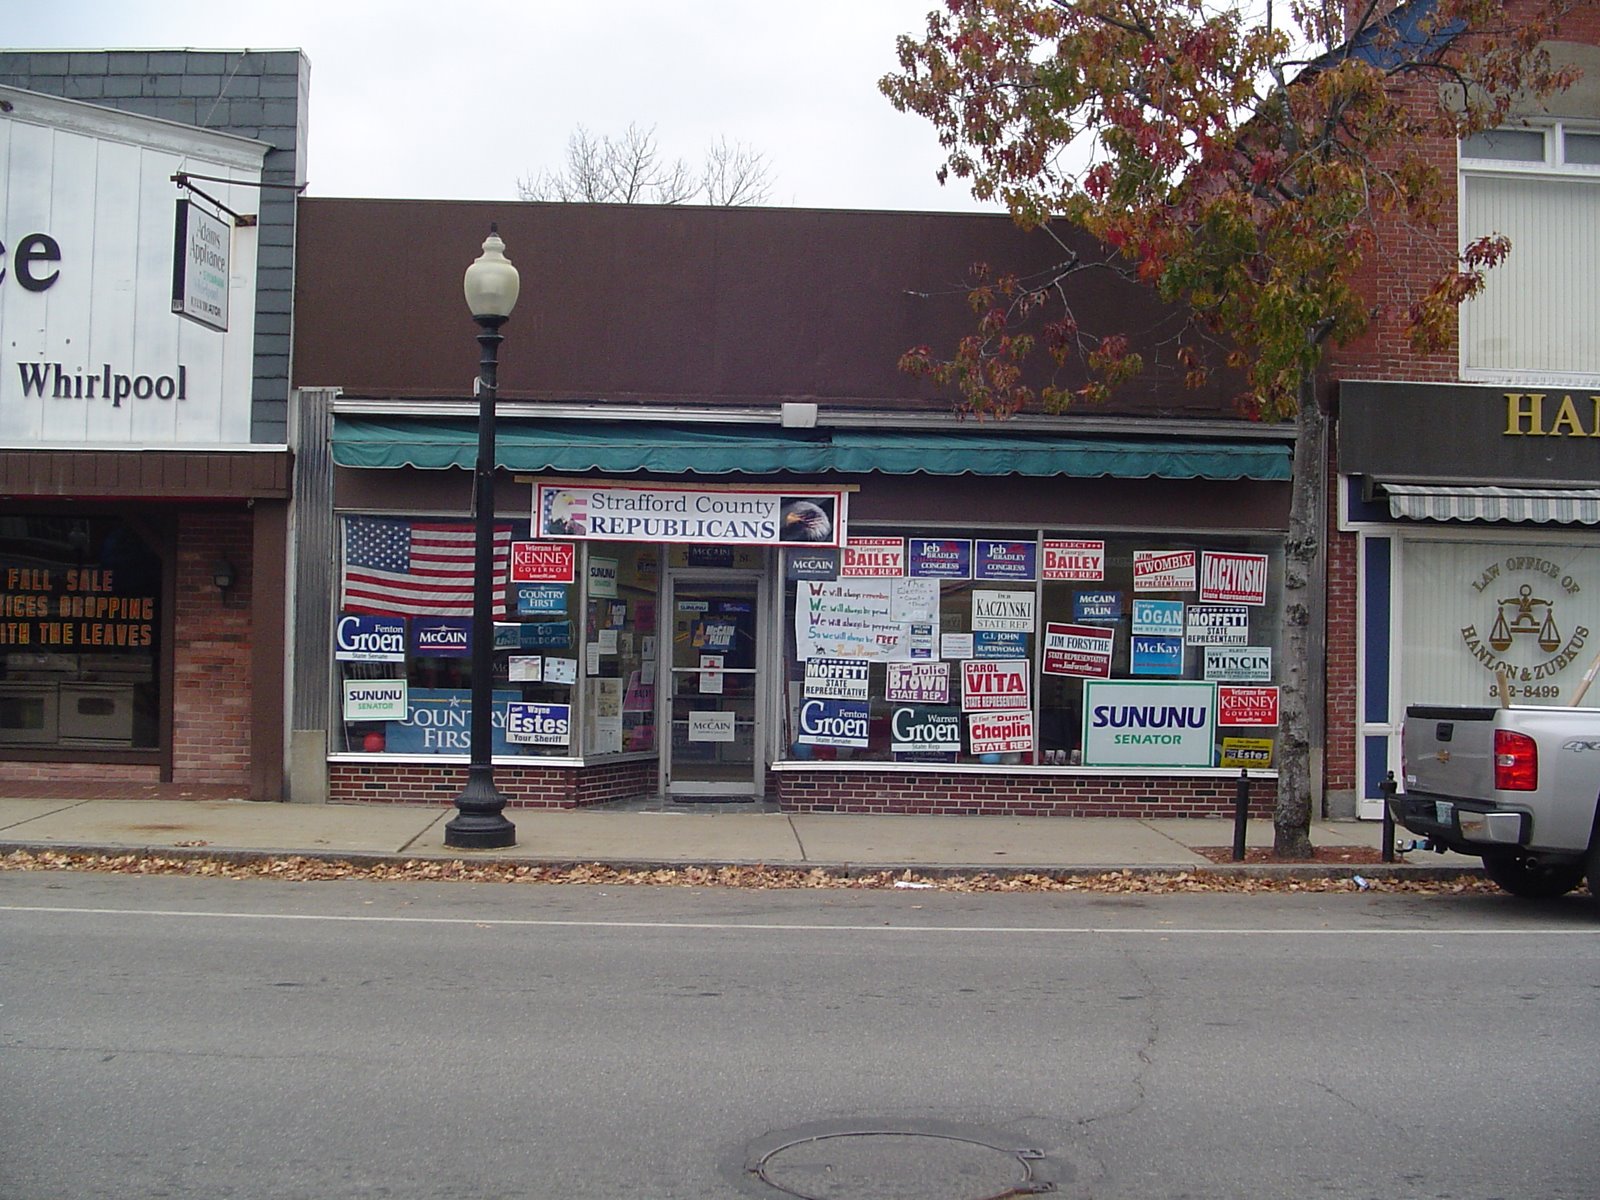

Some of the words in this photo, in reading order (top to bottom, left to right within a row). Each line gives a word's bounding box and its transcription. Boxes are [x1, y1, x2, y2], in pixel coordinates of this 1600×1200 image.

[196, 215, 222, 249] Adams
[189, 236, 226, 273] Appliance
[0, 232, 62, 293] e
[17, 362, 187, 408] Whirlpool
[1503, 393, 1600, 438] HA
[591, 492, 688, 514] Strafford
[695, 496, 776, 518] County
[590, 516, 776, 540] REPUBLICANS
[920, 542, 941, 556] Jeb
[987, 544, 1007, 558] Jeb
[514, 552, 572, 565] KENNEY
[844, 548, 901, 567] BAILEY
[926, 552, 960, 560] BRADLEY
[1045, 551, 1100, 570] BAILEY
[793, 560, 834, 570] McCAIN
[920, 562, 960, 570] CONGRESS
[1135, 554, 1192, 576] TWOMBLY
[590, 567, 616, 579] SUNUNU
[843, 568, 877, 577] STATE
[878, 568, 901, 577] REP.
[1045, 571, 1077, 579] STATE
[1078, 571, 1101, 580] REP.
[1471, 562, 1501, 593] LAW
[1505, 556, 1561, 579] OFFICE
[1561, 575, 1581, 594] OF
[8, 568, 53, 592] FALL
[66, 568, 113, 593] SALE
[907, 580, 925, 589] The
[1135, 580, 1194, 588] REPRESENTATIVE
[519, 589, 564, 599] COUNTRY
[809, 582, 827, 597] We
[829, 587, 843, 597] will
[843, 588, 862, 601] always
[529, 599, 555, 607] FIRST
[1079, 594, 1116, 604] McCAIN
[0, 593, 49, 618] ICES
[59, 596, 154, 620] DROPPING
[809, 598, 827, 612] We
[830, 603, 844, 613] will
[844, 604, 862, 615] always
[976, 598, 1032, 618] KACZYNSKI
[1083, 607, 1112, 616] PALIN
[809, 612, 826, 626] We
[828, 617, 842, 627] will
[1134, 606, 1182, 624] LOGAN
[1188, 613, 1247, 627] MOFFETT
[374, 623, 404, 634] Fenton
[537, 626, 553, 635] GO
[705, 625, 736, 636] McCAIN
[977, 620, 1007, 628] STATE
[39, 623, 73, 645] THE
[81, 623, 152, 646] LEAVES
[337, 616, 405, 652] Groen
[419, 631, 467, 643] McCAIN
[808, 626, 821, 639] So
[834, 632, 846, 641] will
[876, 634, 899, 646] FREE
[982, 632, 997, 640] G.I.
[997, 633, 1020, 641] JOHN
[1206, 627, 1228, 635] STATE
[1049, 635, 1064, 648] JIM
[1066, 637, 1110, 652] FORSYTHE
[1187, 635, 1247, 645] REPRESENTATIVE
[977, 645, 1025, 653] SUPERWOMAN
[1135, 642, 1180, 657] McKay
[1519, 667, 1532, 681] &
[1533, 625, 1590, 680] ZUBKUS
[1048, 651, 1064, 660] STATE
[1063, 652, 1108, 664] REPRESENTATIVE
[1207, 656, 1269, 669] MINCIN
[807, 663, 867, 680] MOFFETT
[914, 666, 946, 676] Julie
[966, 664, 999, 673] CAROL
[825, 679, 848, 688] STATE
[889, 671, 946, 691] Brown
[967, 673, 1024, 693] VITA
[349, 690, 402, 701] SUNUNU
[806, 686, 867, 697] REPRESENTATIVE
[890, 689, 918, 700] STATE
[922, 690, 944, 701] REP.
[1231, 688, 1257, 696] Veterans
[1489, 685, 1560, 698] 32-8499
[965, 696, 982, 708] STATE
[982, 695, 1027, 707] REPRESENTATIVE
[1221, 696, 1277, 709] KENNEY
[527, 705, 551, 715] Wayne
[839, 709, 868, 719] Fenton
[509, 713, 568, 734] Estes
[801, 700, 869, 738] Groen
[927, 714, 958, 723] Warren
[1092, 705, 1207, 729] SUNUNU
[693, 721, 731, 731] McCAIN
[891, 707, 960, 742] Groen
[972, 722, 1031, 740] Chaplin
[423, 727, 471, 748] FIRS
[513, 734, 532, 742] Your
[534, 735, 562, 743] Sheriff
[1114, 734, 1182, 745] SENATOR
[928, 743, 940, 751] Rep
[973, 742, 1007, 752] STATE
[1010, 741, 1031, 749] REP
[1237, 750, 1269, 760] Estes
